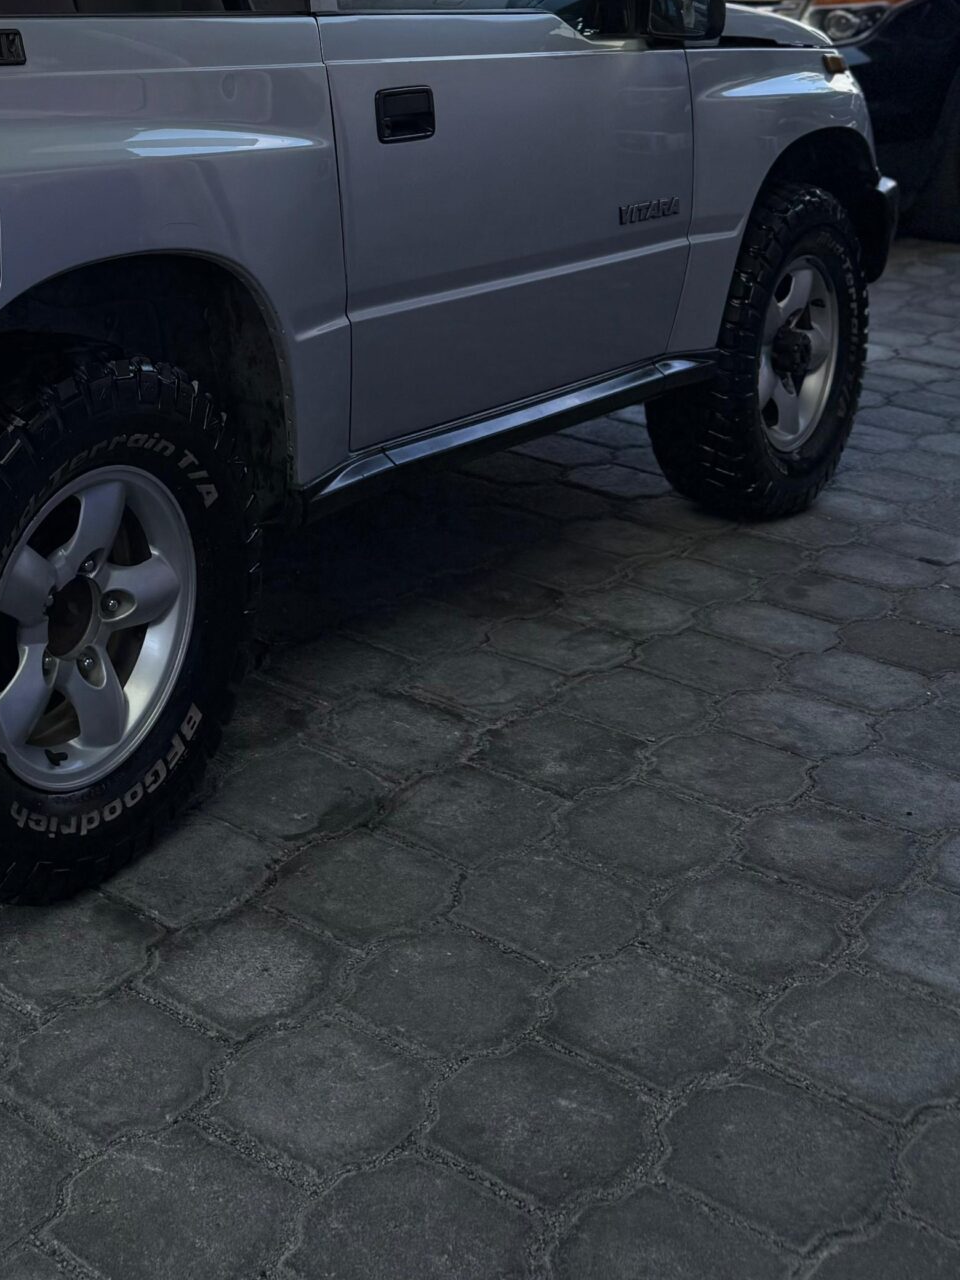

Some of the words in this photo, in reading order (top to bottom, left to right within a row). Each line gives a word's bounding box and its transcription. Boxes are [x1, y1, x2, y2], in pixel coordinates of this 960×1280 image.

[618, 196, 681, 226] VITARA
[176, 448, 220, 510] T/A
[9, 701, 205, 840] BFGoodrich
